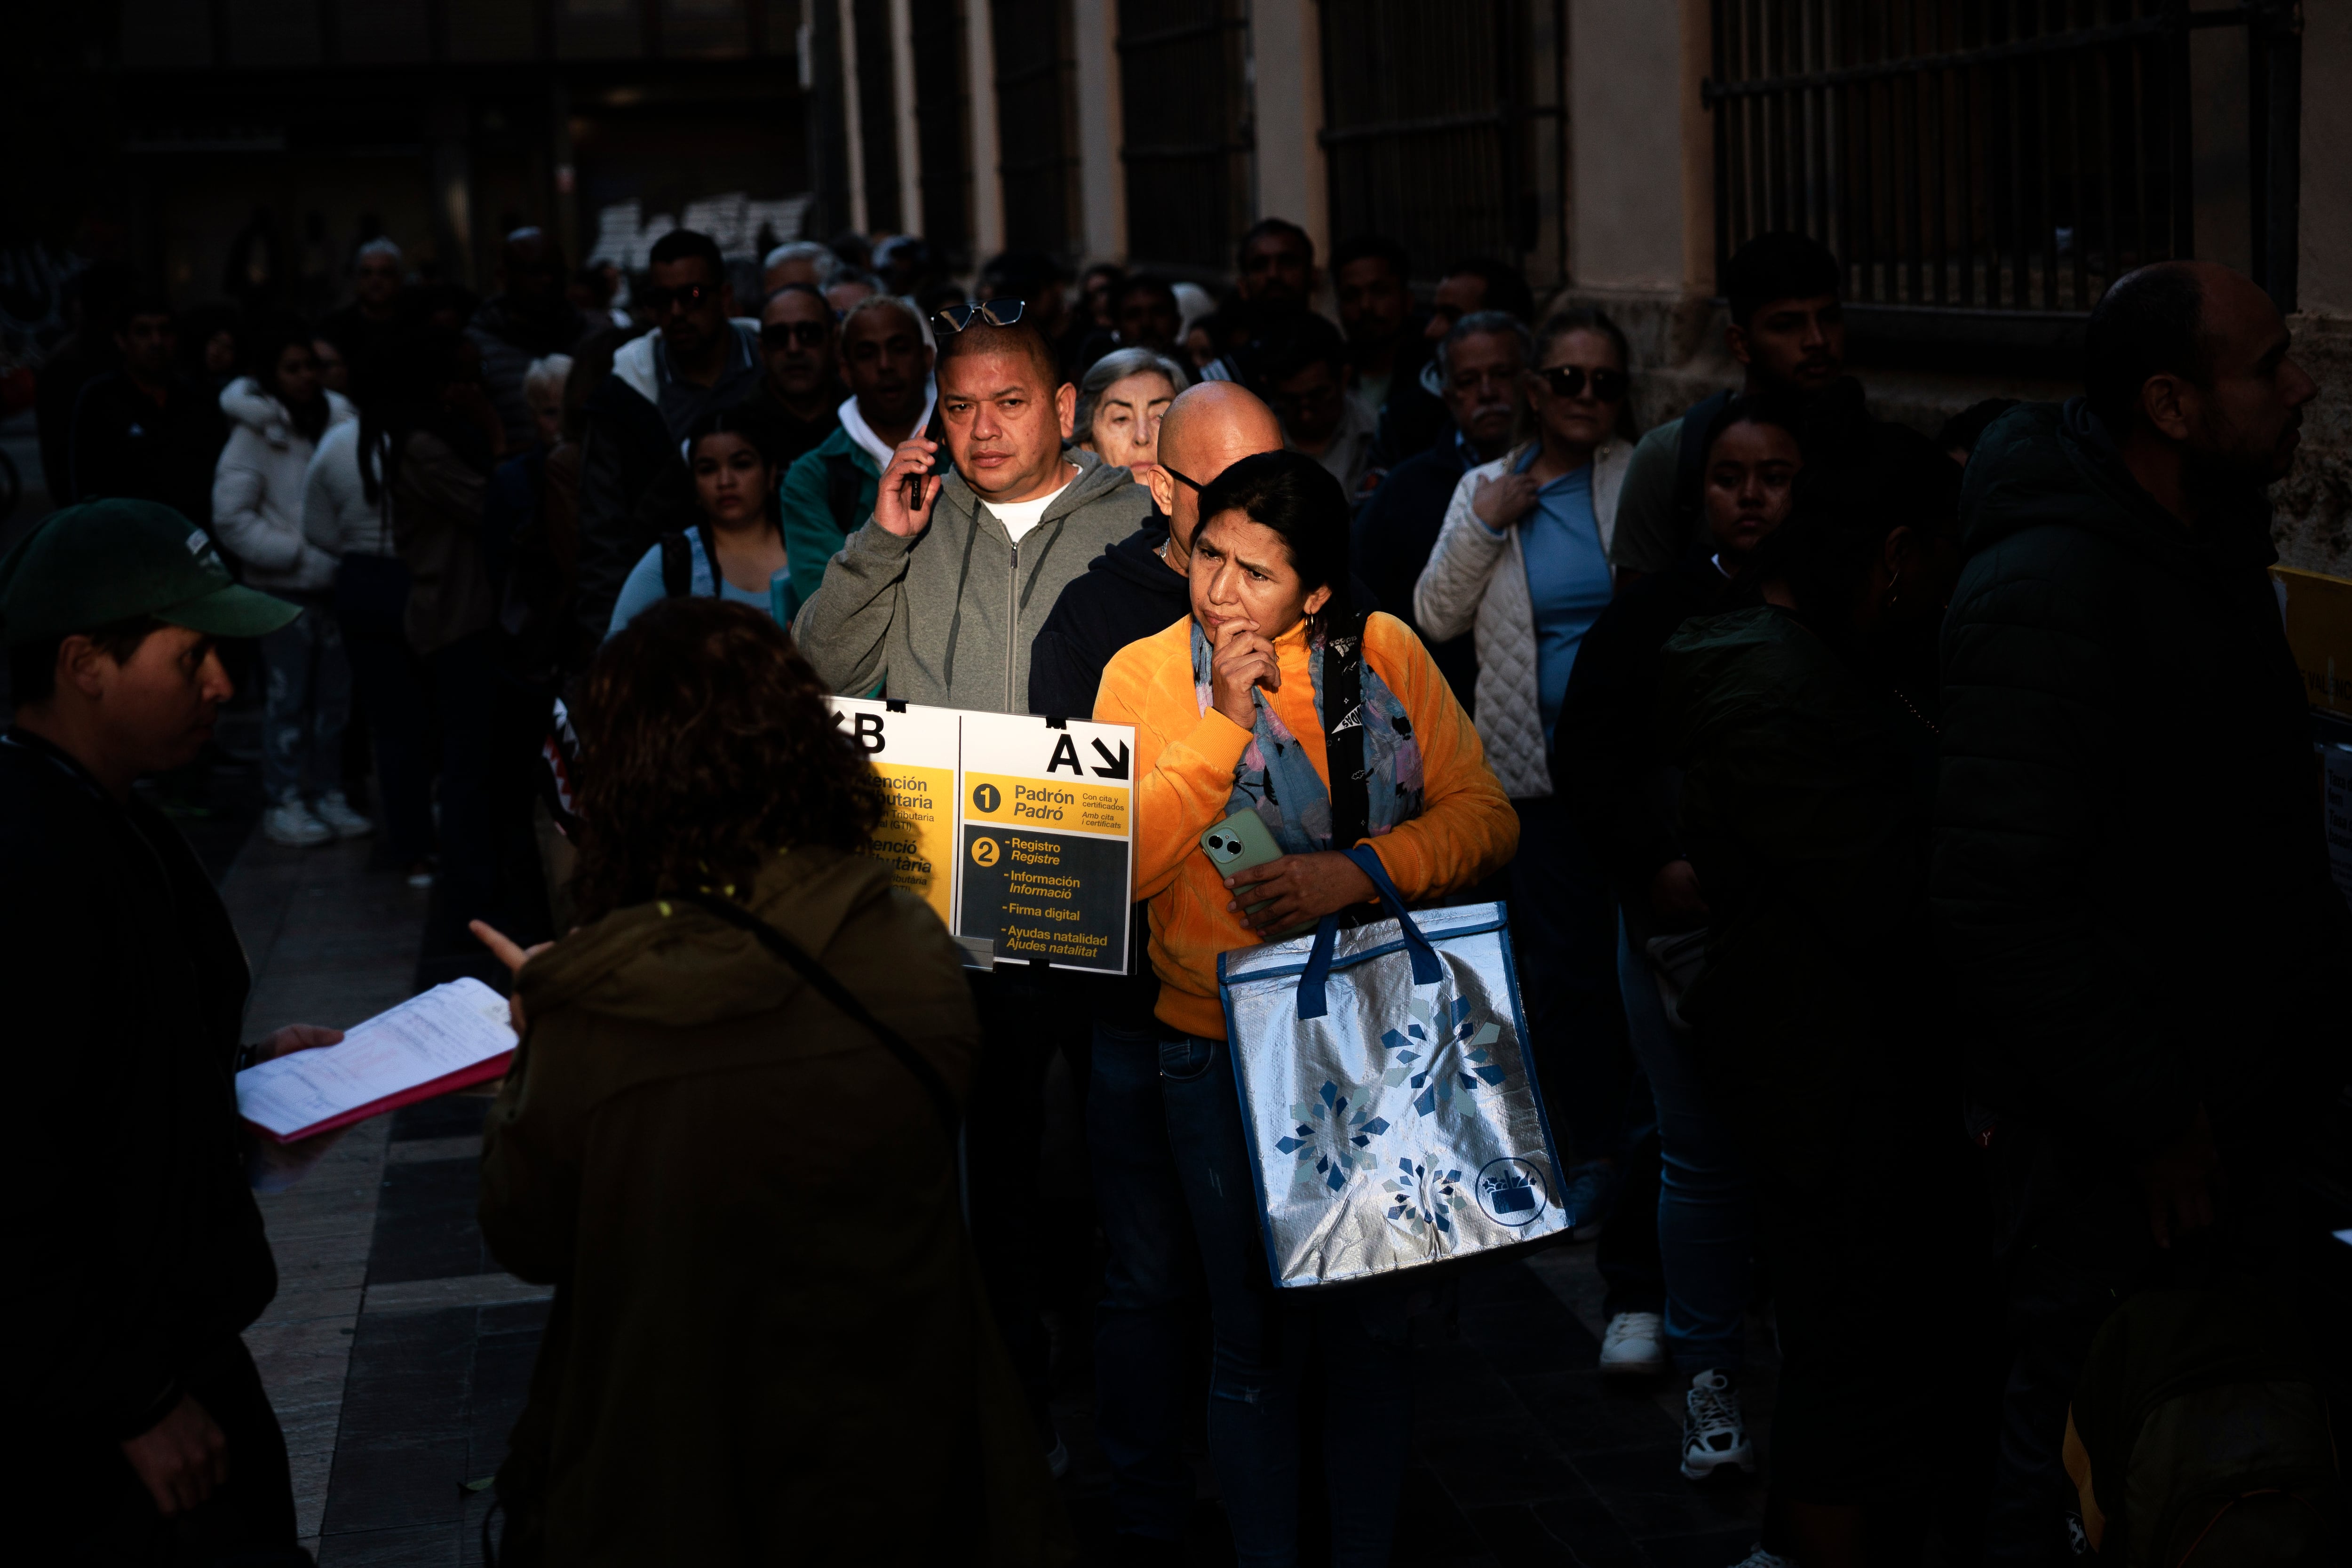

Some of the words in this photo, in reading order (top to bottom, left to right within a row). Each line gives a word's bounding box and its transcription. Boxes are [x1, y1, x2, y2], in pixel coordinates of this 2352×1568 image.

[855, 712, 885, 754] B
[1047, 734, 1083, 776] A
[866, 773, 927, 791] tención
[980, 788, 991, 809] 1
[1015, 785, 1074, 804] Padrón
[1014, 802, 1064, 820] Padró
[1082, 801, 1125, 811] certificados
[892, 809, 935, 822] Tributaria
[1085, 820, 1121, 828] certificats
[890, 821, 912, 832] (GTI)
[978, 841, 993, 863] 2
[1011, 850, 1060, 865] Registre
[1009, 883, 1072, 899] Informació
[1044, 907, 1081, 921] digital
[1006, 938, 1047, 951] Ajudes
[1049, 944, 1098, 957] natalitat
[1053, 932, 1108, 947] natalidad
